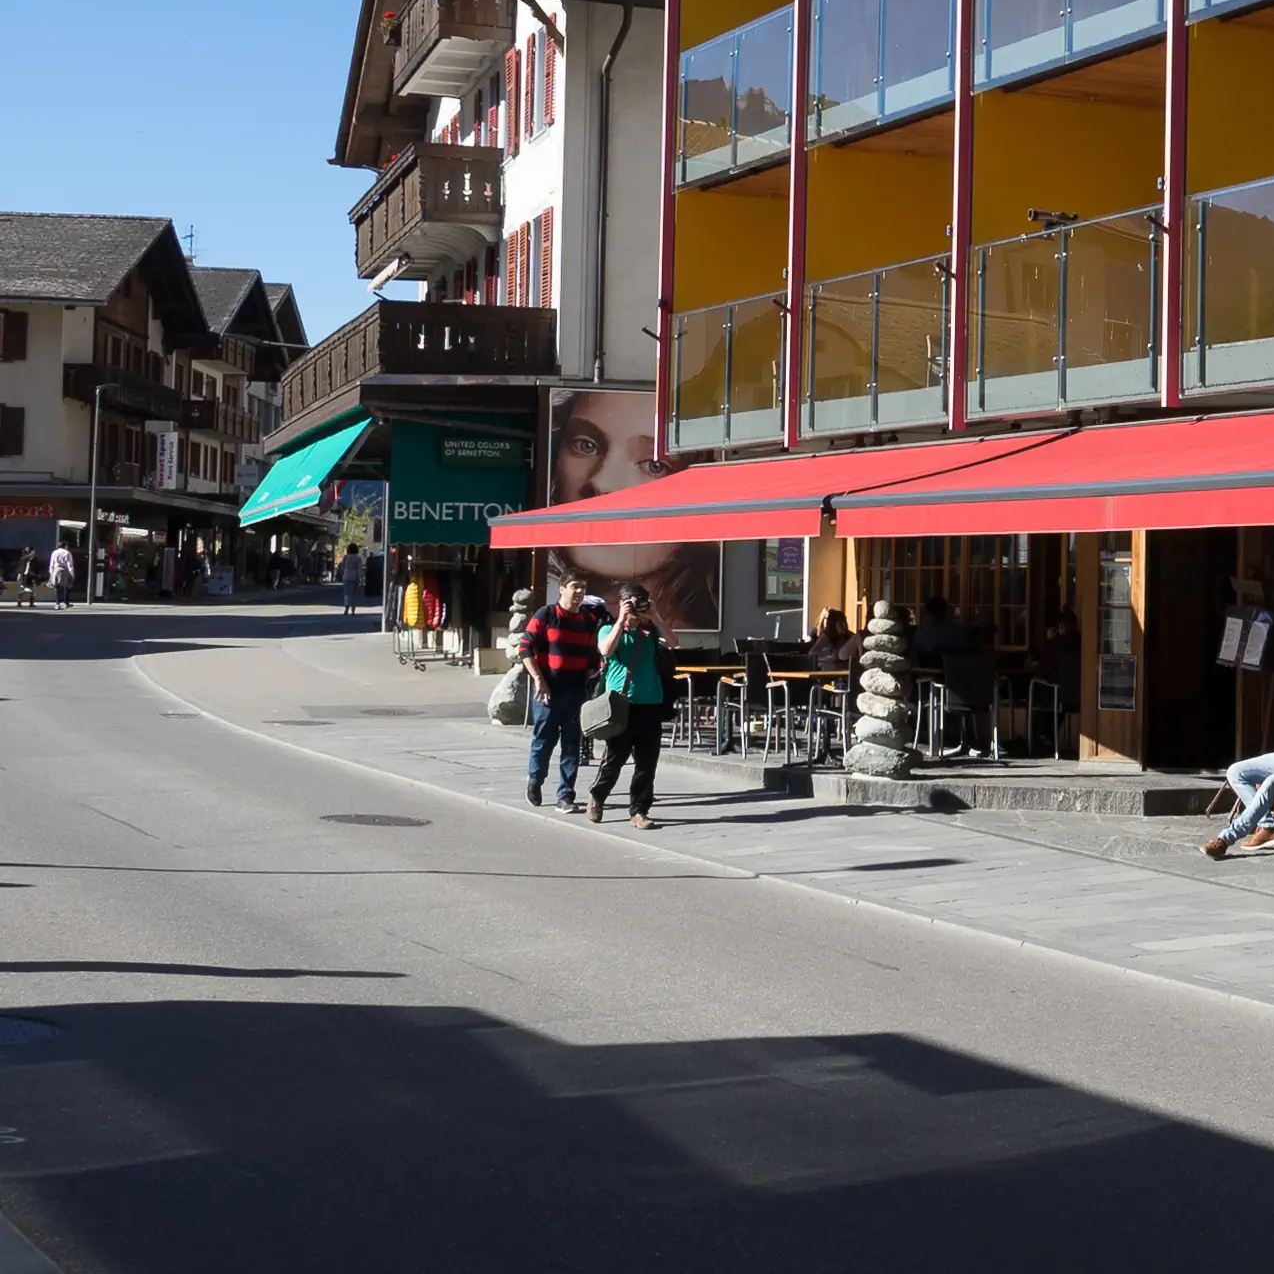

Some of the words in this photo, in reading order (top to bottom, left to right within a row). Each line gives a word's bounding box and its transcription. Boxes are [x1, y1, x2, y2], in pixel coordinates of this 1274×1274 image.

[444, 441, 475, 449] UNITED
[477, 441, 510, 449] COLORS
[393, 501, 523, 521] BENETTON
